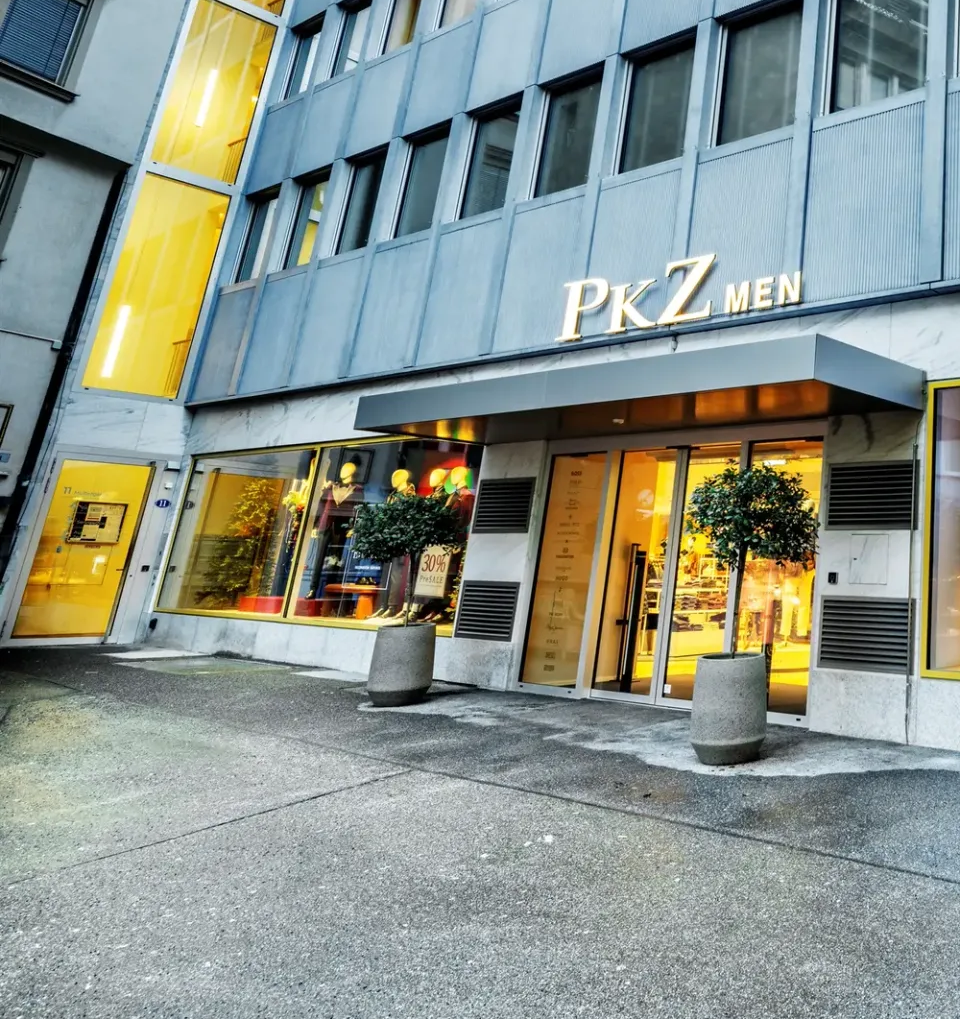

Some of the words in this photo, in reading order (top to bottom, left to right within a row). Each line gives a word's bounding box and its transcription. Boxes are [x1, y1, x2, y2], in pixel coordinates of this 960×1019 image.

[554, 253, 717, 342] PKZ
[724, 271, 802, 315] MEN
[421, 553, 446, 573] 30%
